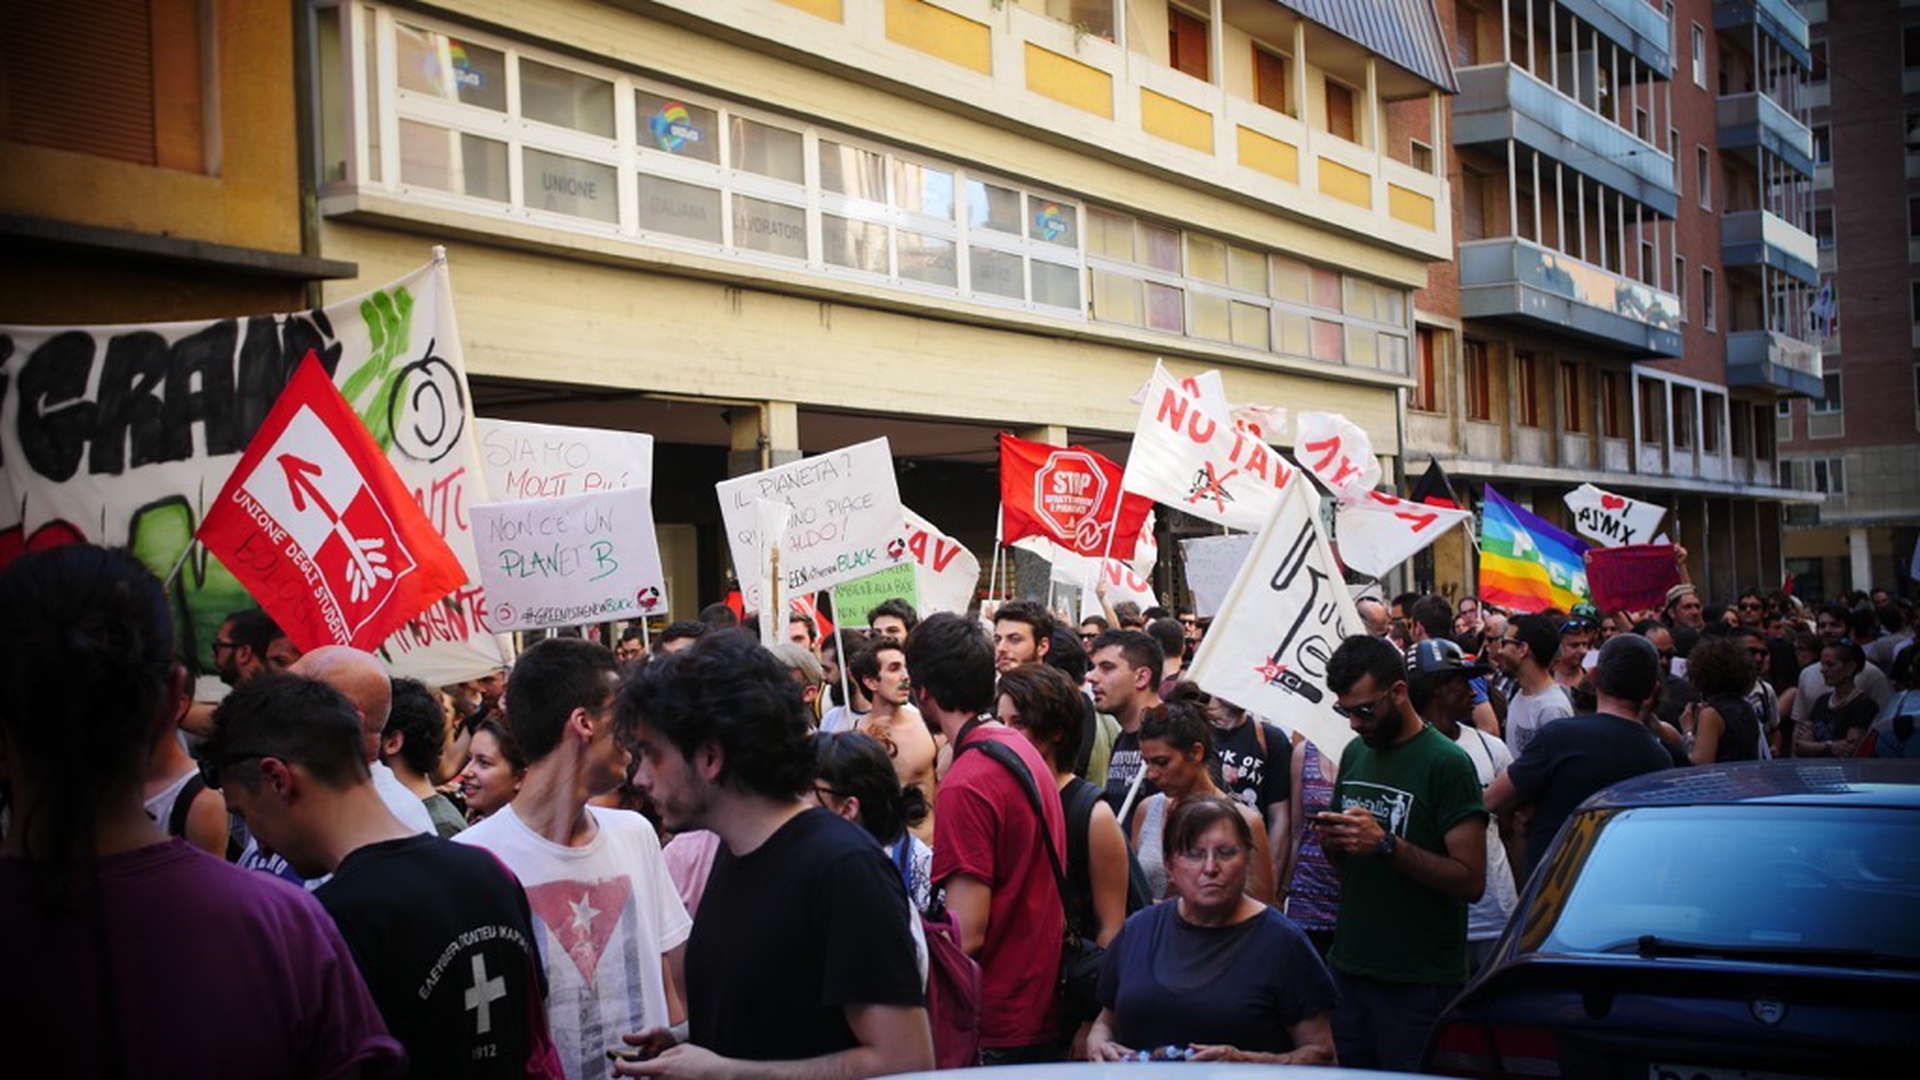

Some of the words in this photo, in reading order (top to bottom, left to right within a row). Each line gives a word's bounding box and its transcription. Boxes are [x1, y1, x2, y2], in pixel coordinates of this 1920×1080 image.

[542, 171, 598, 200] UNIONE
[484, 429, 591, 468] SIAMO
[733, 491, 752, 511] IL
[1053, 471, 1092, 503] STOP
[826, 493, 875, 517] PIACE
[489, 512, 533, 543] NON
[584, 506, 616, 535] UN
[231, 488, 288, 546] UNIONE
[285, 543, 319, 586] DEGLI
[313, 585, 349, 647] STUDENT
[498, 543, 585, 579] PLANET
[588, 540, 619, 583] B
